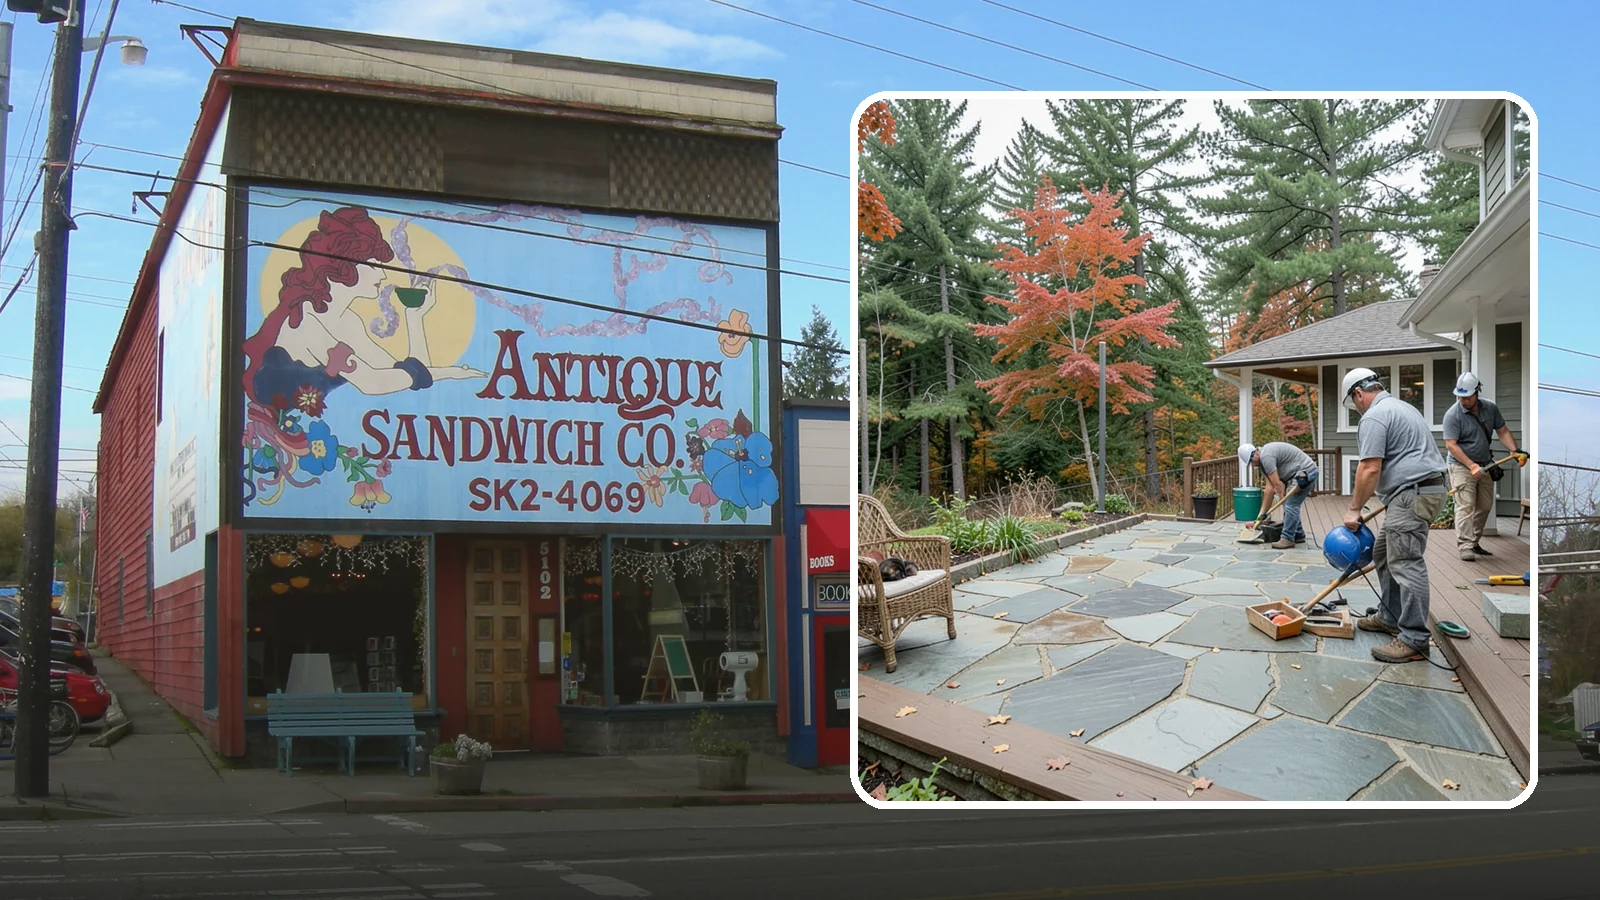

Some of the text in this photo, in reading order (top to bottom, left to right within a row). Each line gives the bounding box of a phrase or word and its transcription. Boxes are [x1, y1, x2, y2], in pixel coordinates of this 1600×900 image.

[475, 329, 724, 421] ANTIQUE
[361, 408, 685, 469] SANDWICH CO.
[468, 477, 646, 513] SK2-4069
[540, 541, 551, 600] 5102
[809, 554, 835, 569] BOOKS
